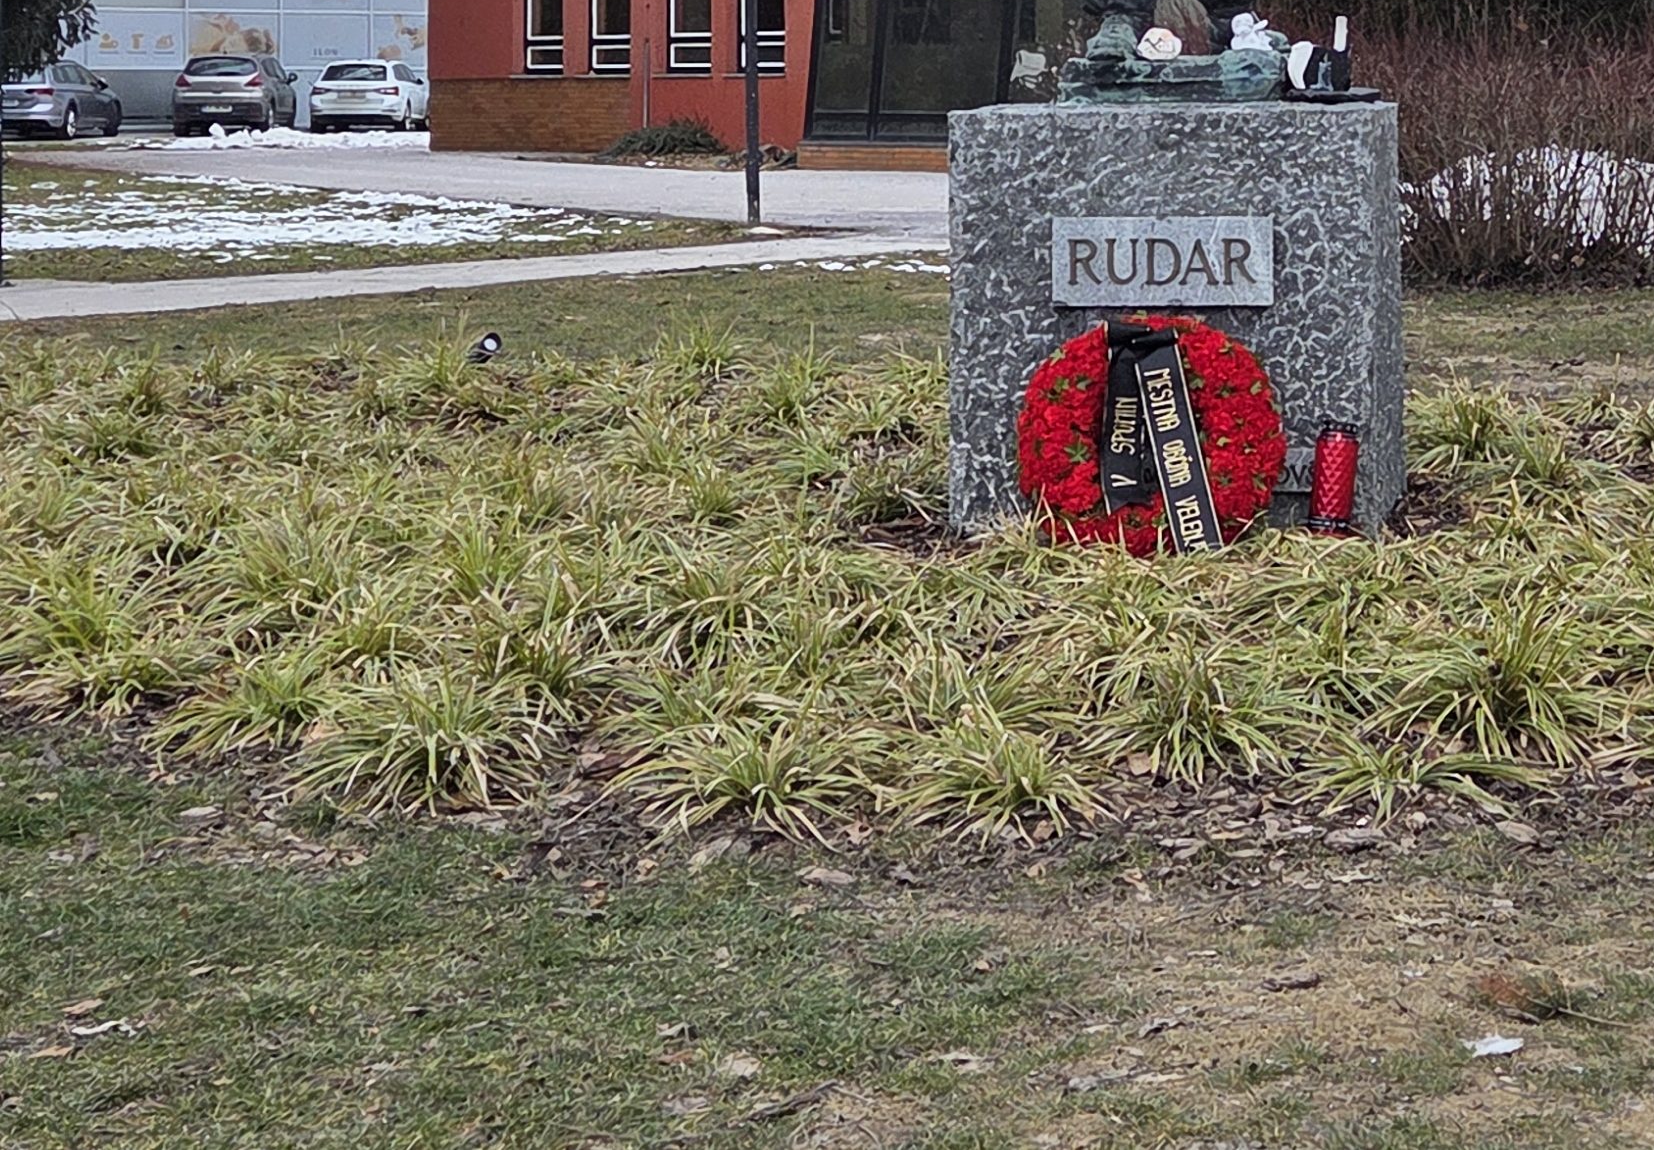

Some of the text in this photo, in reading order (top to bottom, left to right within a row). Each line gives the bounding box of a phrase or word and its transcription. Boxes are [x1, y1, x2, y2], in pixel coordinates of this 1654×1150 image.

[1067, 237, 1258, 287] RUDAR
[1143, 367, 1181, 432] MESTNA
[1110, 397, 1138, 488] V SPOMIN
